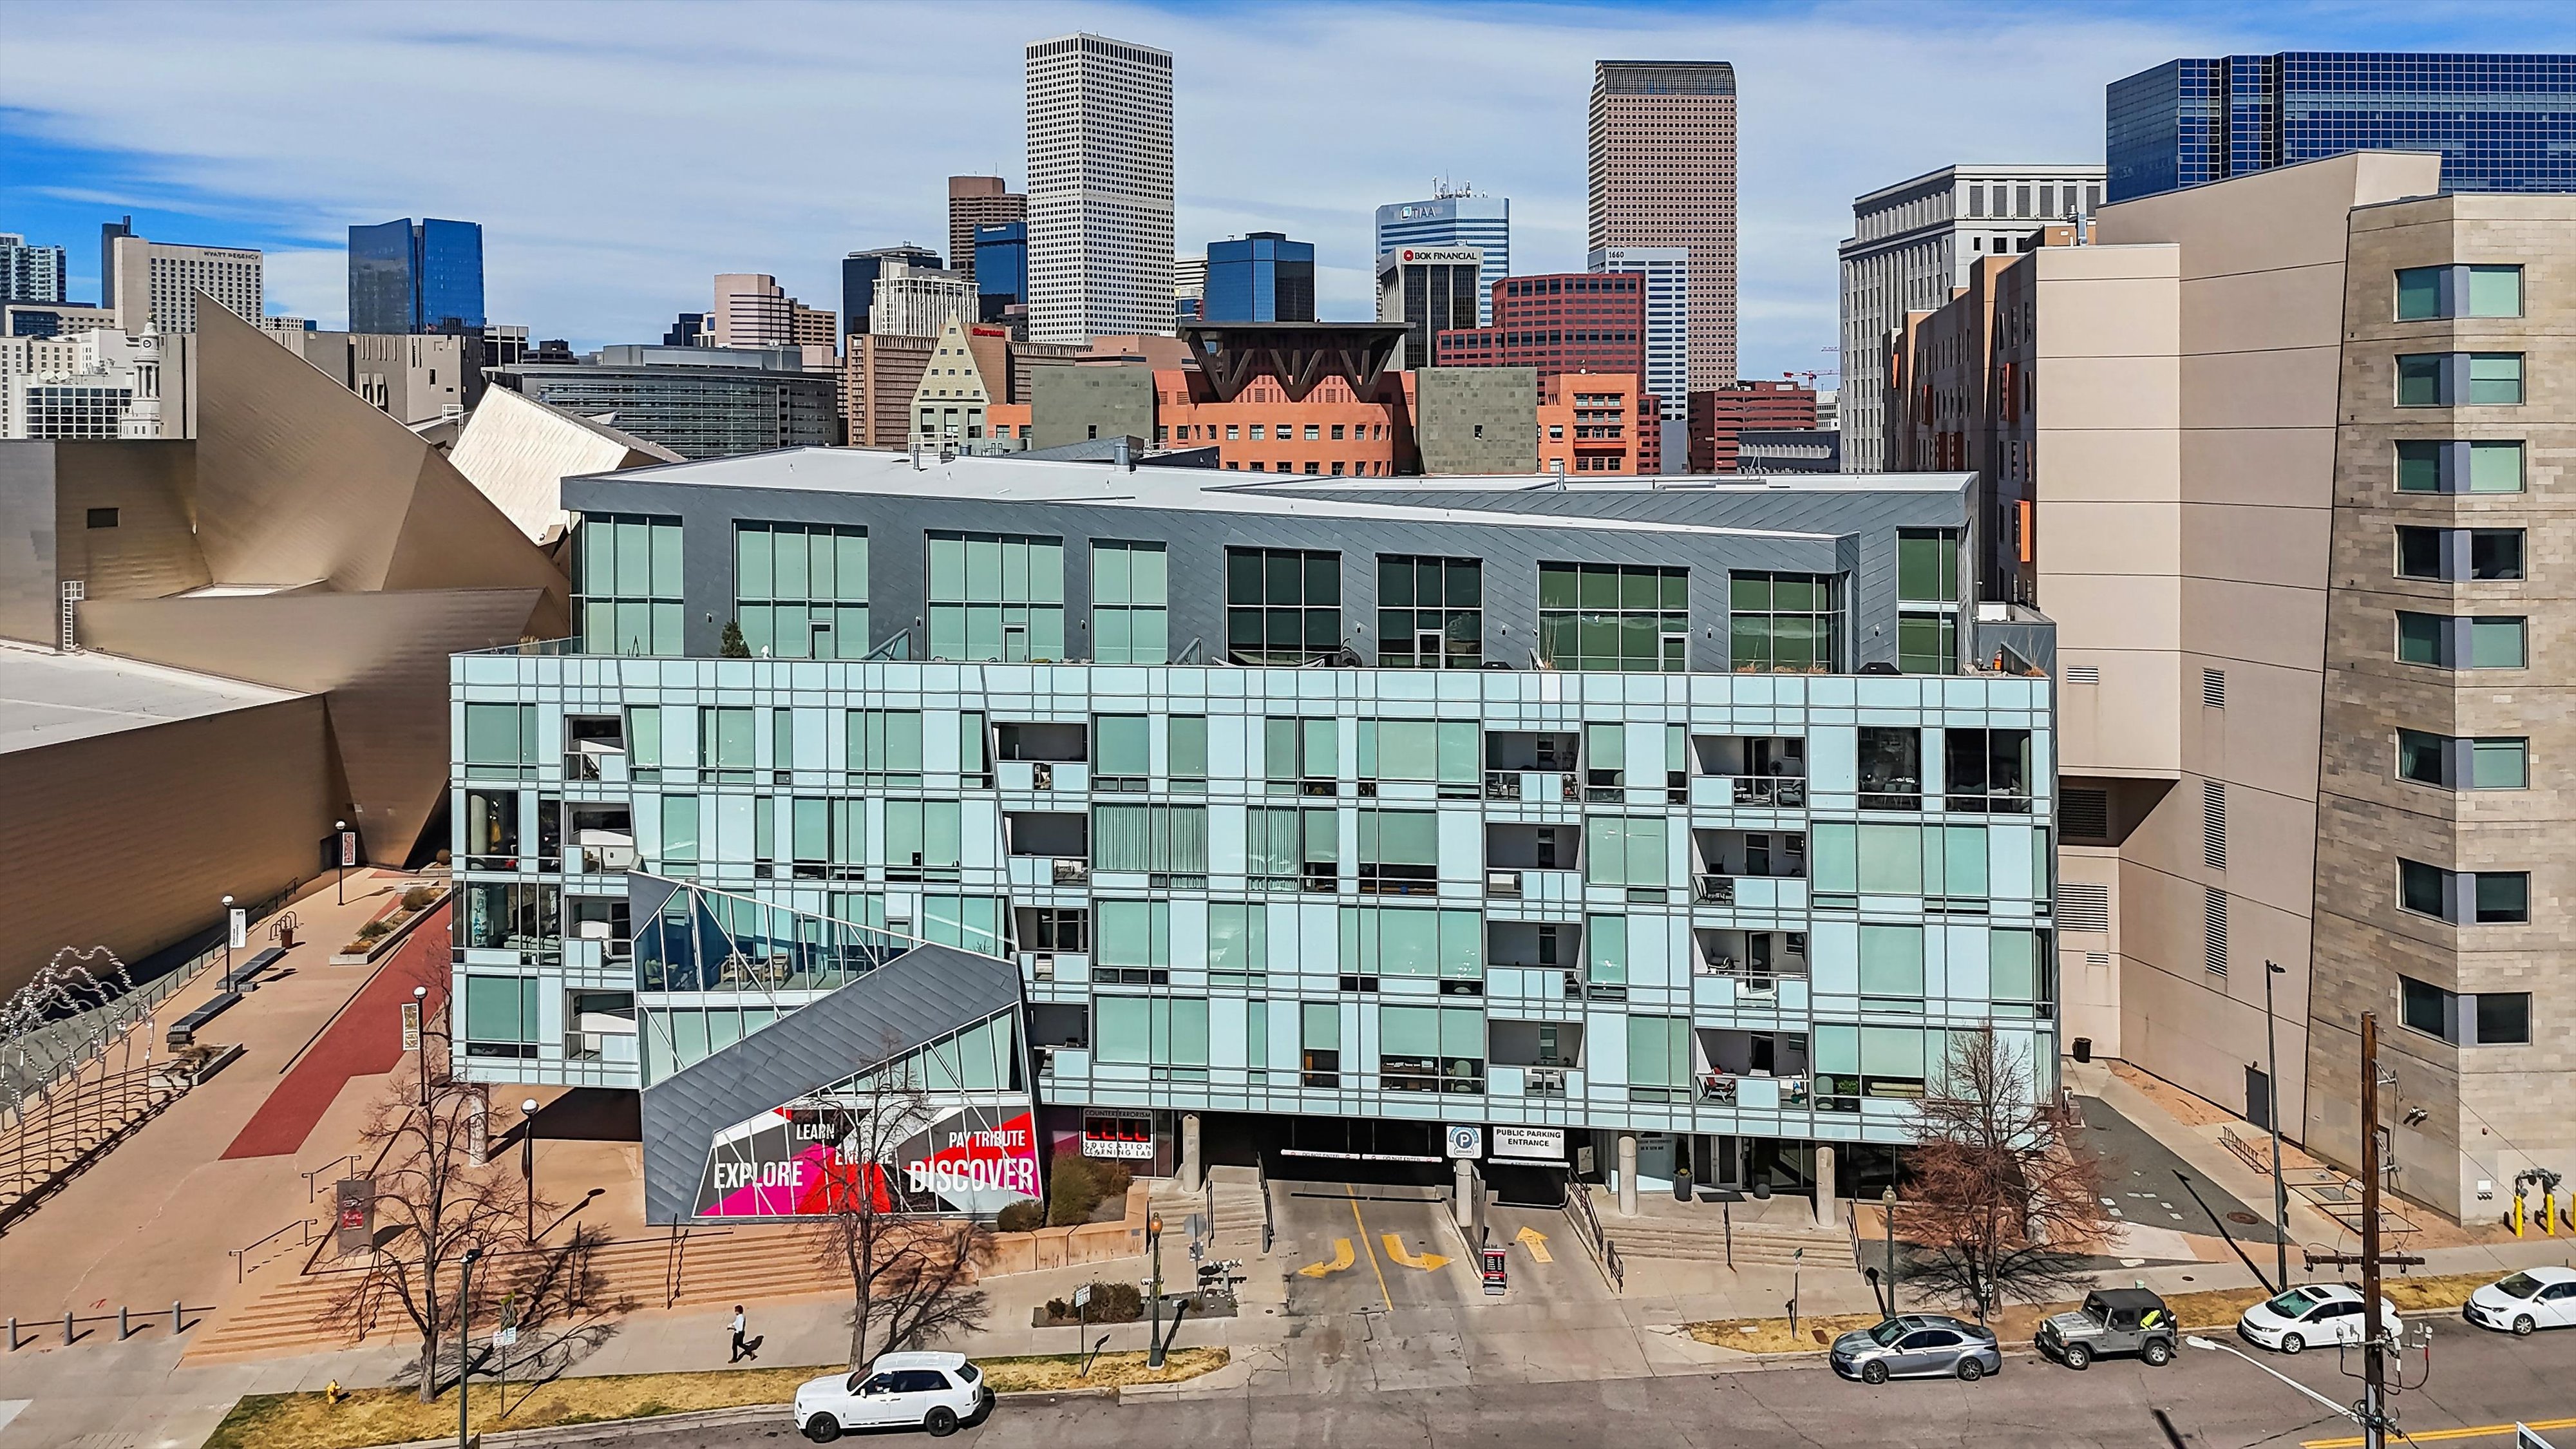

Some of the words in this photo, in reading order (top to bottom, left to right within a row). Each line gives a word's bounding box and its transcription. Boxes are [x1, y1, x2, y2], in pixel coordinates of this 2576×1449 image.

[1412, 207, 1435, 218] TIAA
[797, 1124, 835, 1140] LEARN
[949, 1132, 971, 1148] PAY
[974, 1130, 1025, 1148] TRIBUTE
[1086, 1119, 1149, 1141] CELL
[714, 1161, 803, 1189] EXPLORE
[910, 1158, 1034, 1193] DISCOVER
